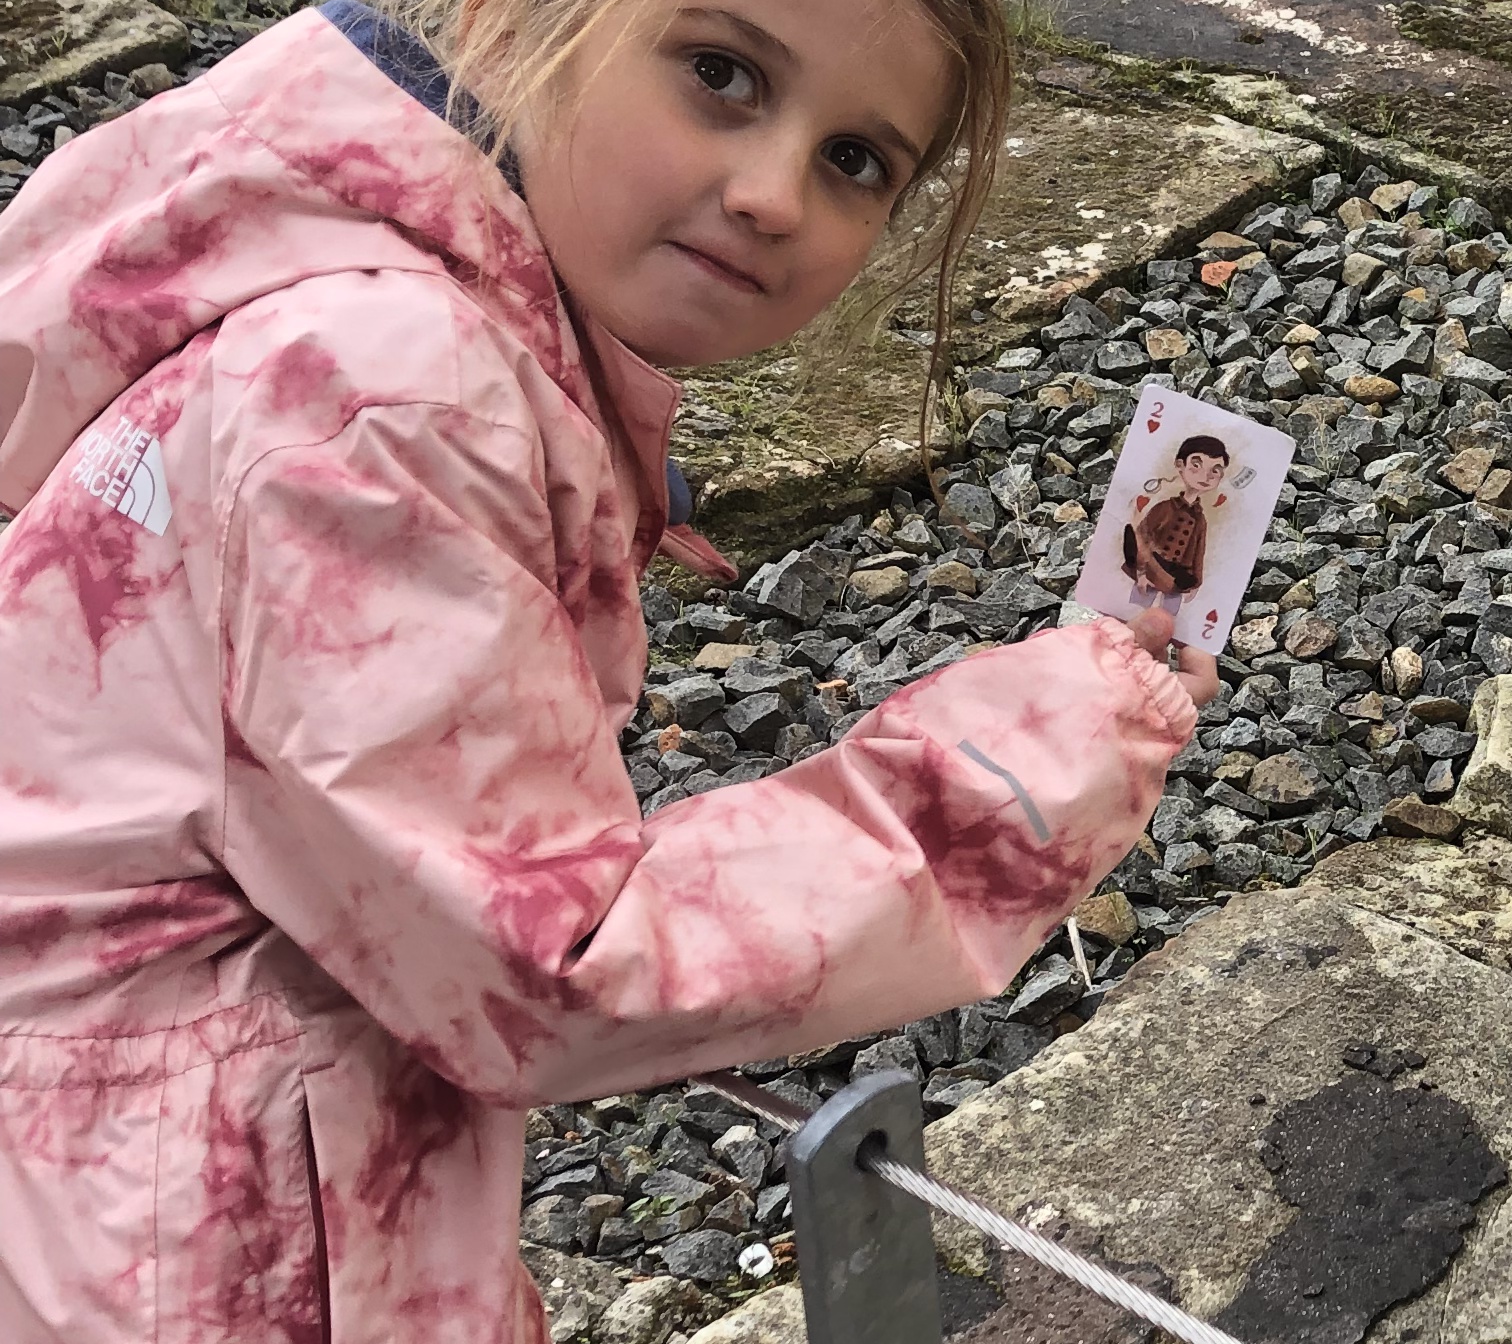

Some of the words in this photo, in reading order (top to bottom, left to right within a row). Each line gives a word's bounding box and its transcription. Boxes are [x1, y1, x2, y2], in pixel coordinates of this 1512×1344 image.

[1150, 401, 1164, 418] 2
[111, 416, 152, 458] THE
[69, 456, 125, 508] FACE
[1202, 623, 1215, 640] 2
